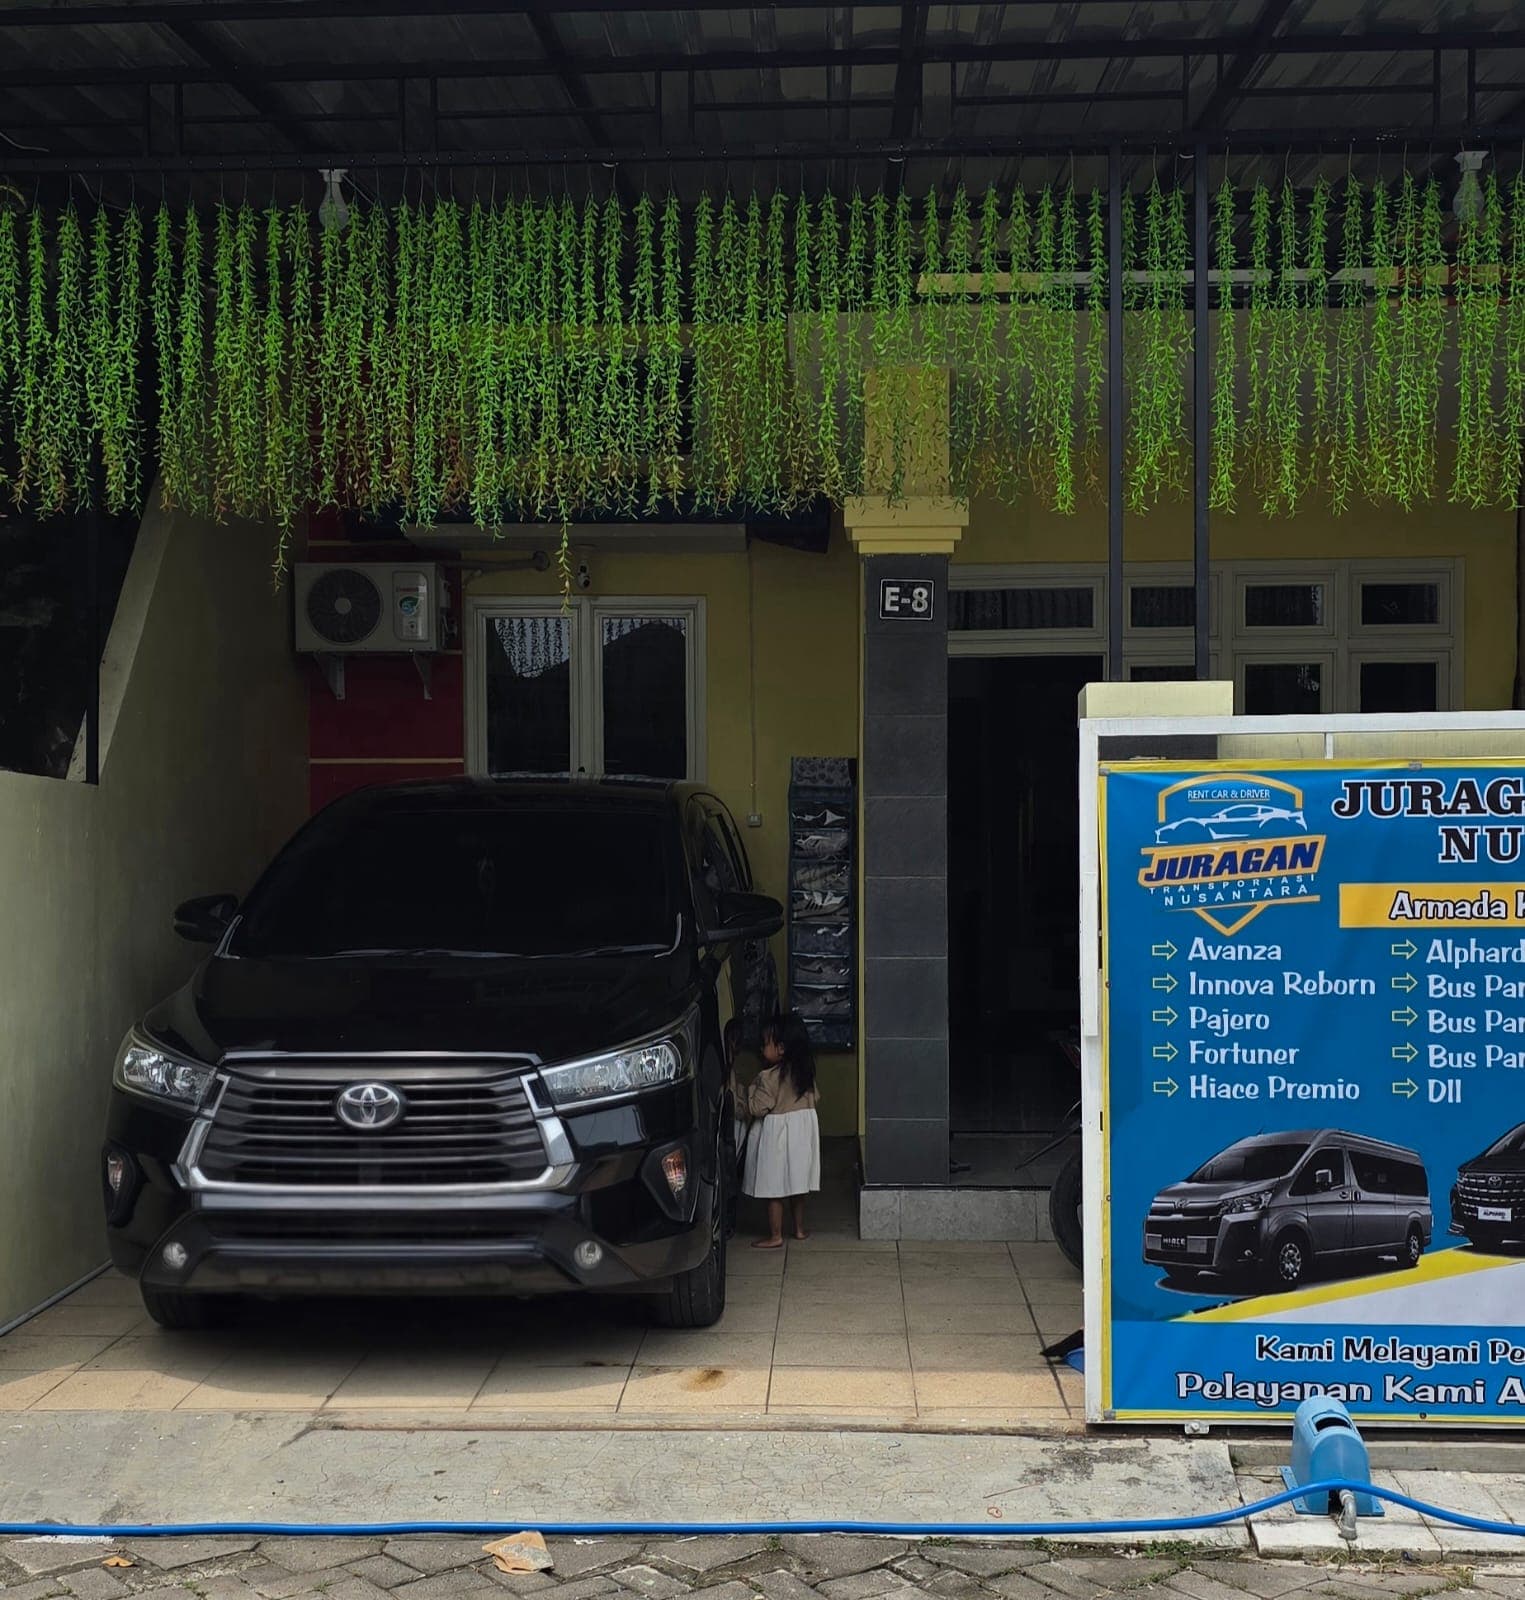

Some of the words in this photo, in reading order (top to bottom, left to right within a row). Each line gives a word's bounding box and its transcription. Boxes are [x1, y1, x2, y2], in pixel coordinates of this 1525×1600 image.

[885, 586, 928, 613] E-8
[1187, 790, 1209, 799] RENT
[1211, 790, 1228, 799] CAR
[1230, 790, 1238, 799] &
[1240, 789, 1270, 799] DRIVER
[1332, 778, 1525, 818] JURAG
[1438, 826, 1525, 863] NU
[1144, 841, 1319, 882] JURAGAN
[1149, 874, 1316, 895] TRANSPORTASI
[1164, 884, 1308, 906] NUSANTARA
[1389, 890, 1507, 921] Armada
[1188, 937, 1282, 961] Avanza
[1426, 938, 1525, 969] Alphard
[1189, 972, 1274, 996] Innova
[1283, 970, 1376, 996] Reborn
[1427, 974, 1476, 998] Bus
[1189, 1007, 1270, 1037] Pajero
[1427, 1009, 1476, 1033] Bus
[1189, 1041, 1300, 1066] Fortuner
[1428, 1044, 1477, 1068] Bus
[1190, 1075, 1260, 1100] Hiace
[1267, 1075, 1360, 1100] Premio
[1256, 1336, 1334, 1362] Kami
[1343, 1336, 1479, 1369] Melayani
[1176, 1373, 1371, 1406] Pelayanan
[1383, 1374, 1485, 1403] Kami
